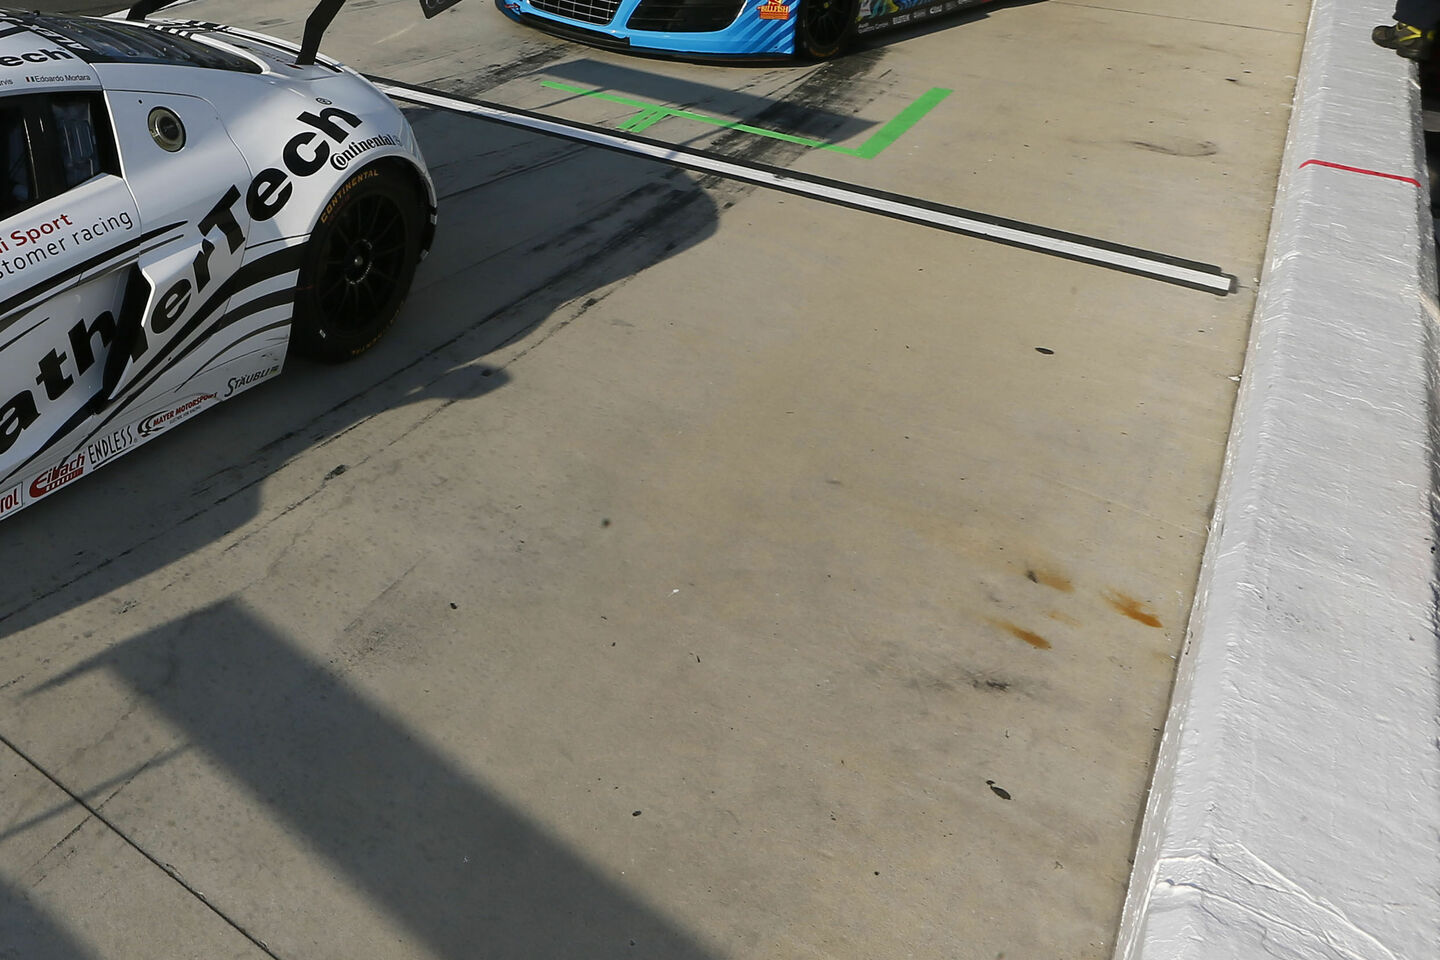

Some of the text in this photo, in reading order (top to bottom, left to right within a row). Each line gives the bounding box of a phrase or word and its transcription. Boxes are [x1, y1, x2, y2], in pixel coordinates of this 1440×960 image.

[35, 73, 91, 83] Edoardo Mortara
[329, 133, 396, 171] Continental
[320, 168, 381, 224] CONTINENTAL
[10, 213, 74, 248] Sport
[73, 208, 134, 251] racing
[153, 392, 218, 427] MAYER MOTORSPORT
[87, 425, 133, 465] ENDLESS
[30, 453, 86, 498] Eibach
